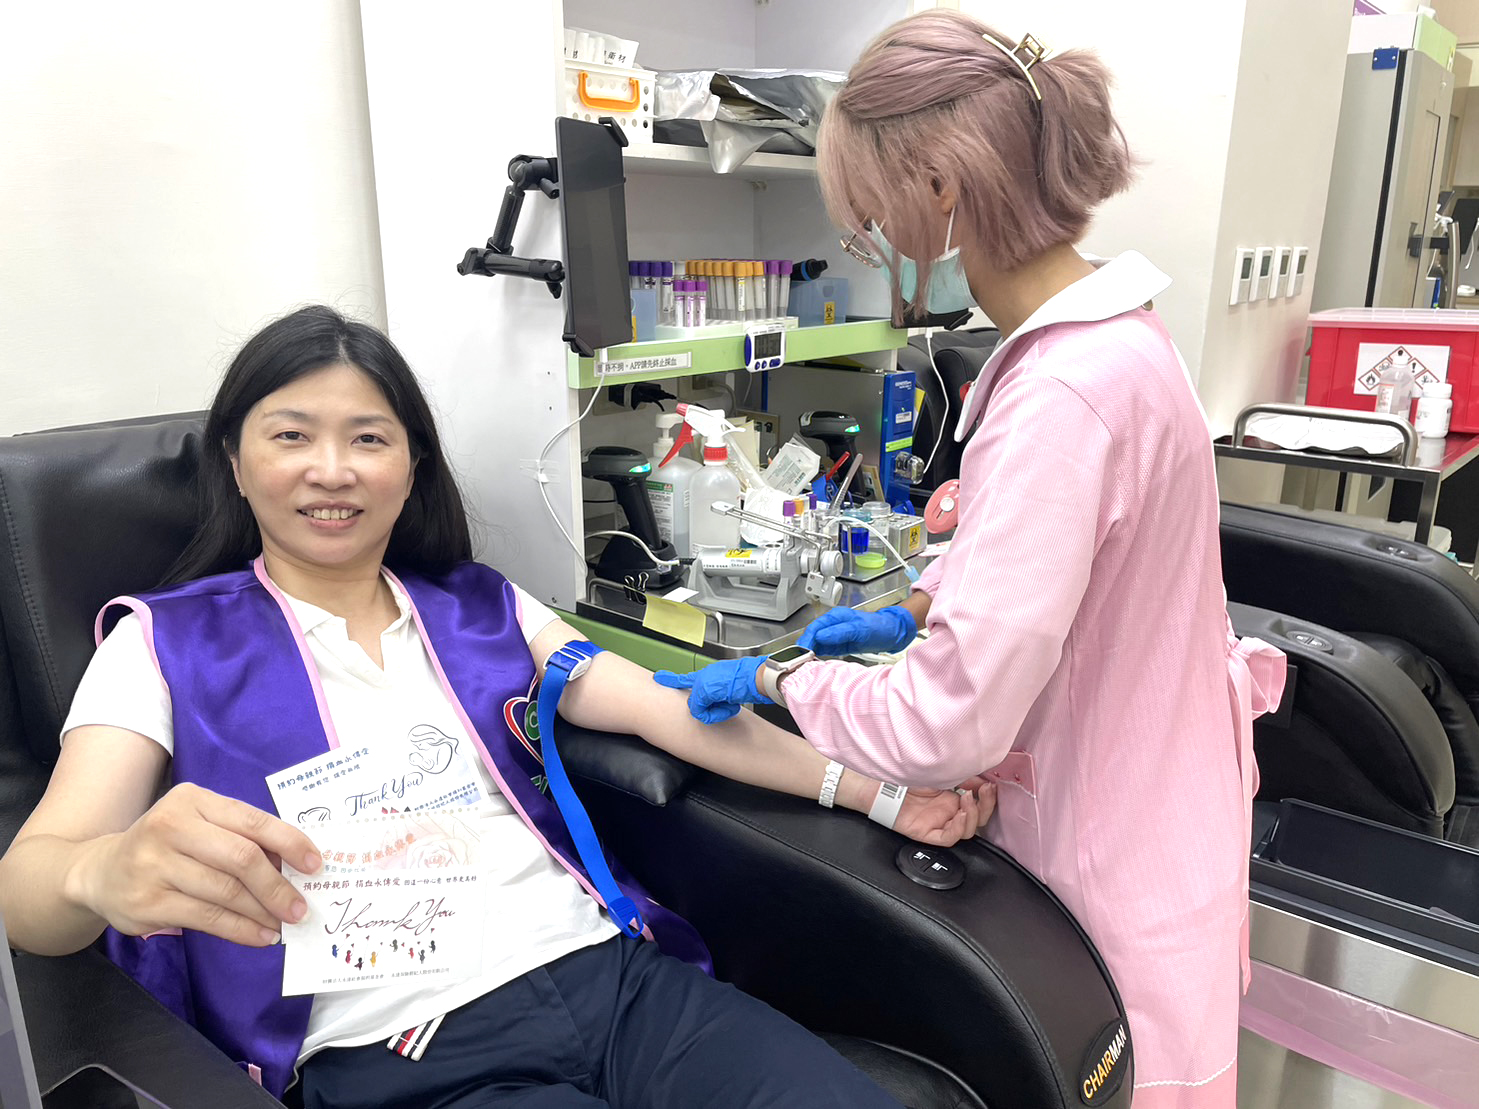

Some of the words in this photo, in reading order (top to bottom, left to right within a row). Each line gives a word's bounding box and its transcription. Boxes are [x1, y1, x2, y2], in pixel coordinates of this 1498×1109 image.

[390, 771, 424, 799] You
[324, 897, 421, 935] Thank
[1083, 1024, 1127, 1099] CHAIRMAN
